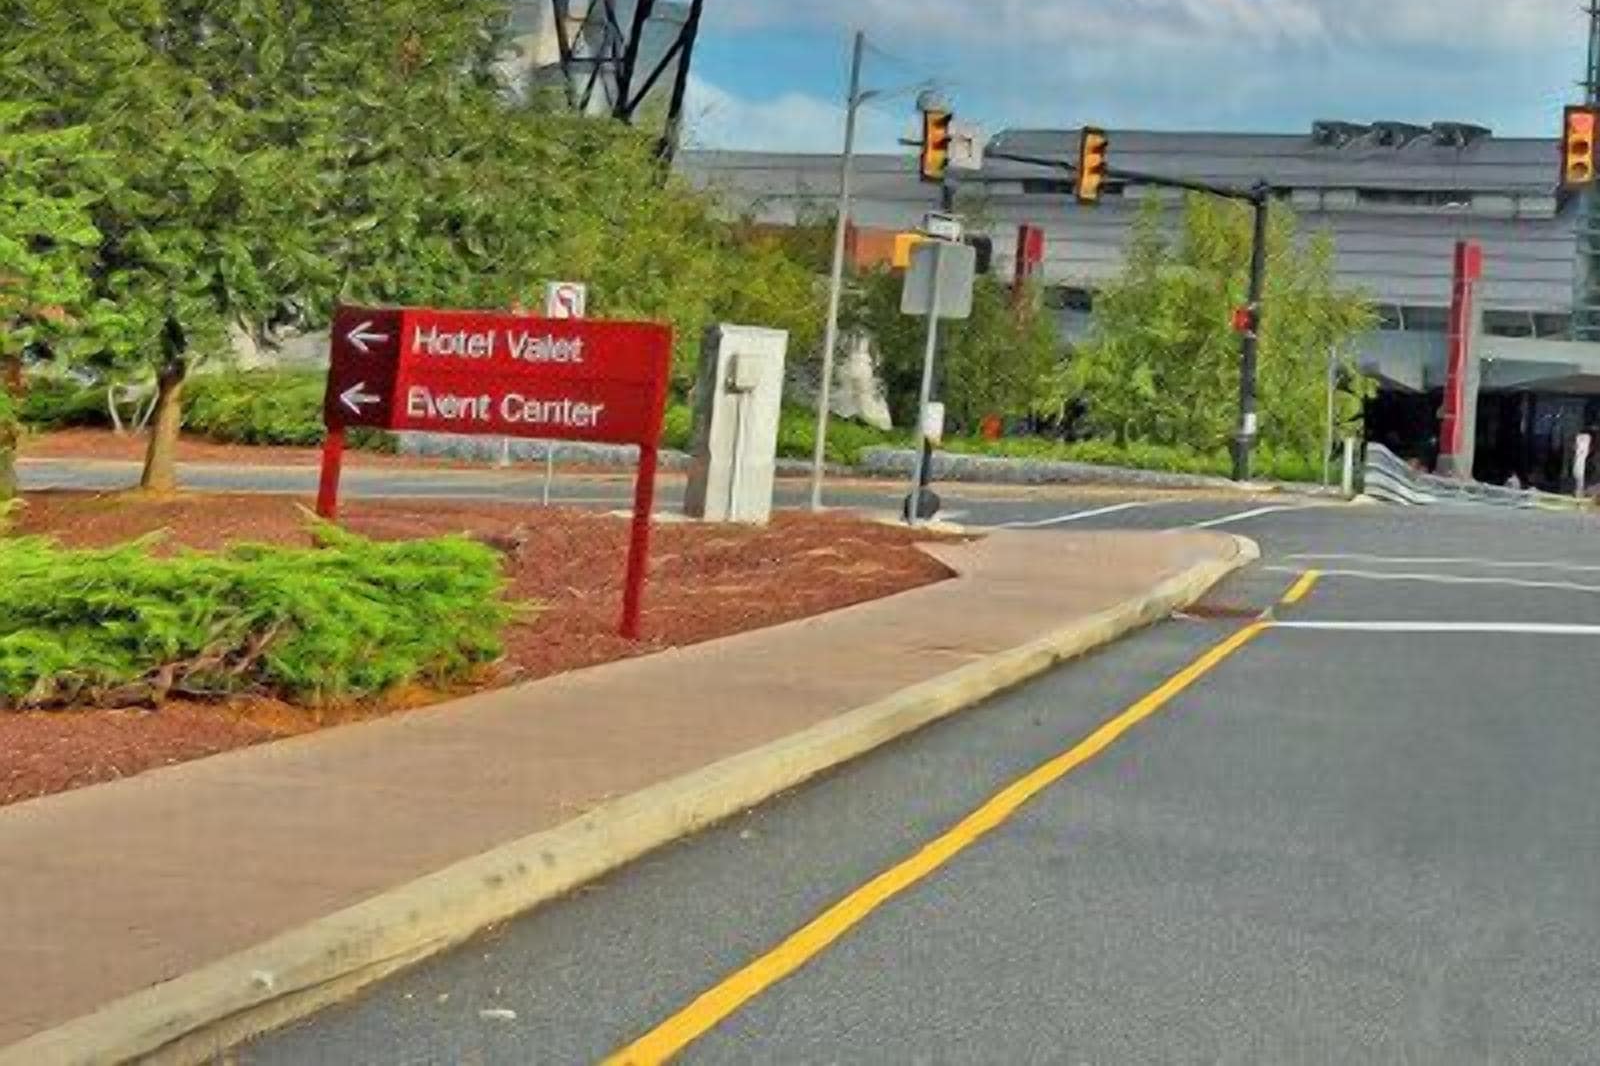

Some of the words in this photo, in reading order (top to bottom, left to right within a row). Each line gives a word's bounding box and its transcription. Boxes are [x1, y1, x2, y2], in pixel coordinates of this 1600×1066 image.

[411, 323, 496, 358] Hotel
[507, 330, 584, 362] Valet
[406, 386, 491, 421] Event
[501, 393, 604, 427] Center
